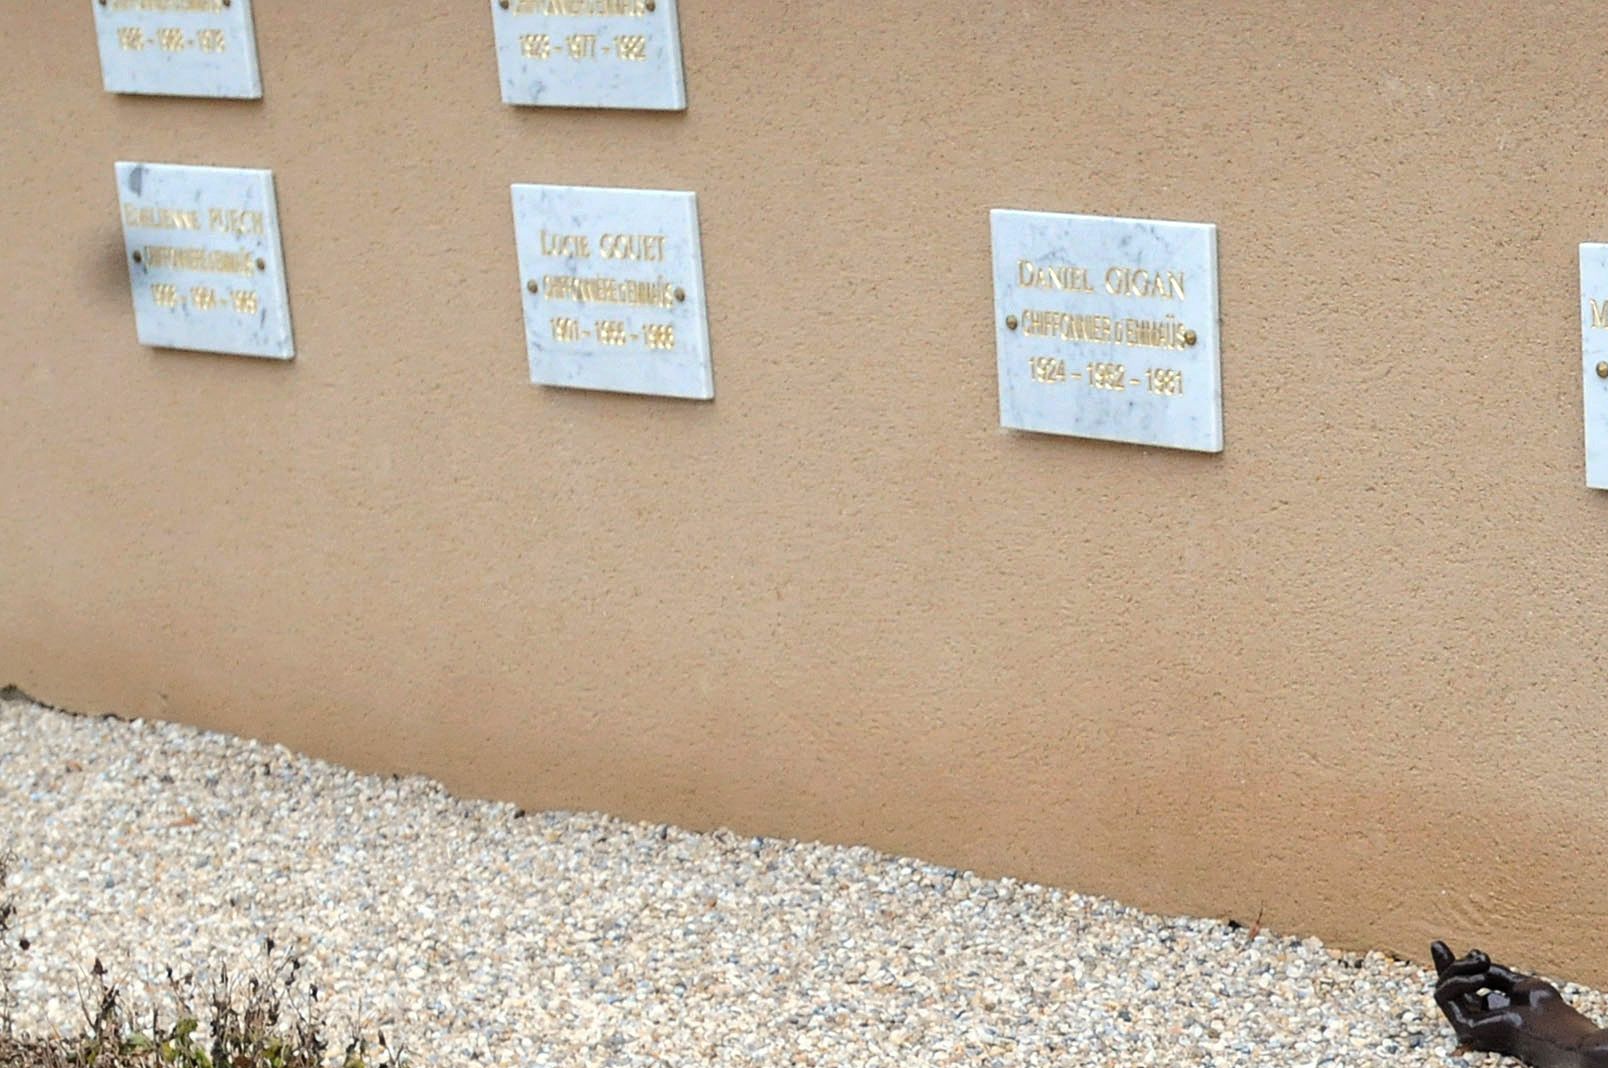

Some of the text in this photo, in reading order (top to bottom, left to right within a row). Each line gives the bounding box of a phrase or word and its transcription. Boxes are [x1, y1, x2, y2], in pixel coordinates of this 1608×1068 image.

[540, 229, 590, 258] LUCIE
[1017, 259, 1185, 301] DANIEL GIGAN
[1029, 356, 1067, 384] 1924
